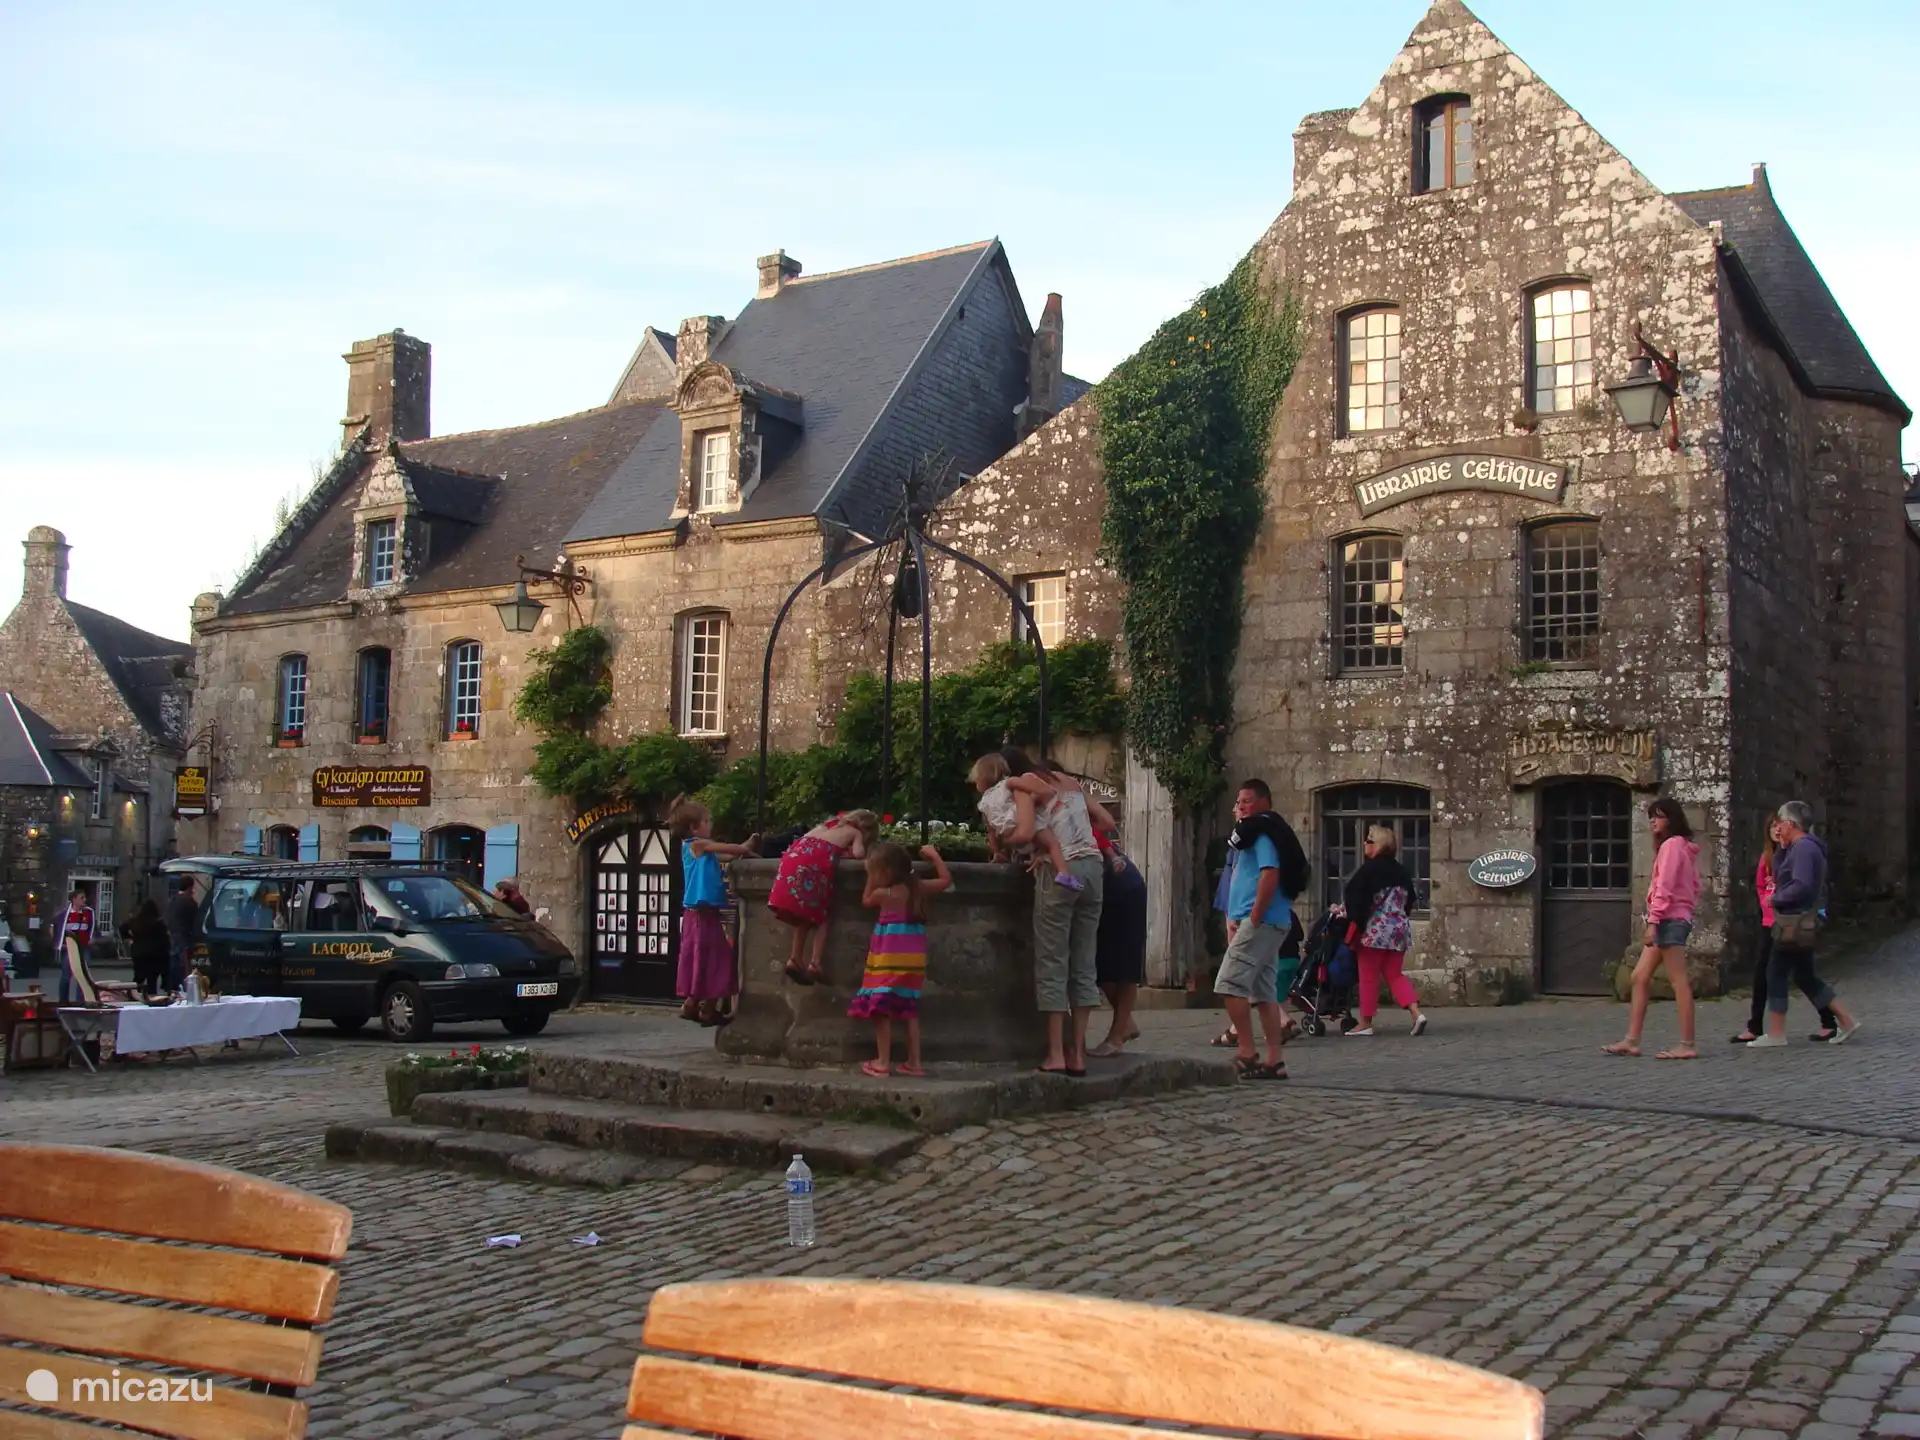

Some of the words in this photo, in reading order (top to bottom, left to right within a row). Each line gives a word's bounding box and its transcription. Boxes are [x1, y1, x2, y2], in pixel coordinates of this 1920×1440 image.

[331, 768, 374, 788] kouign
[375, 769, 424, 784] amann
[321, 796, 359, 806] Biscuitier
[372, 795, 419, 806] Chocolatier
[312, 942, 374, 955] LACROIX
